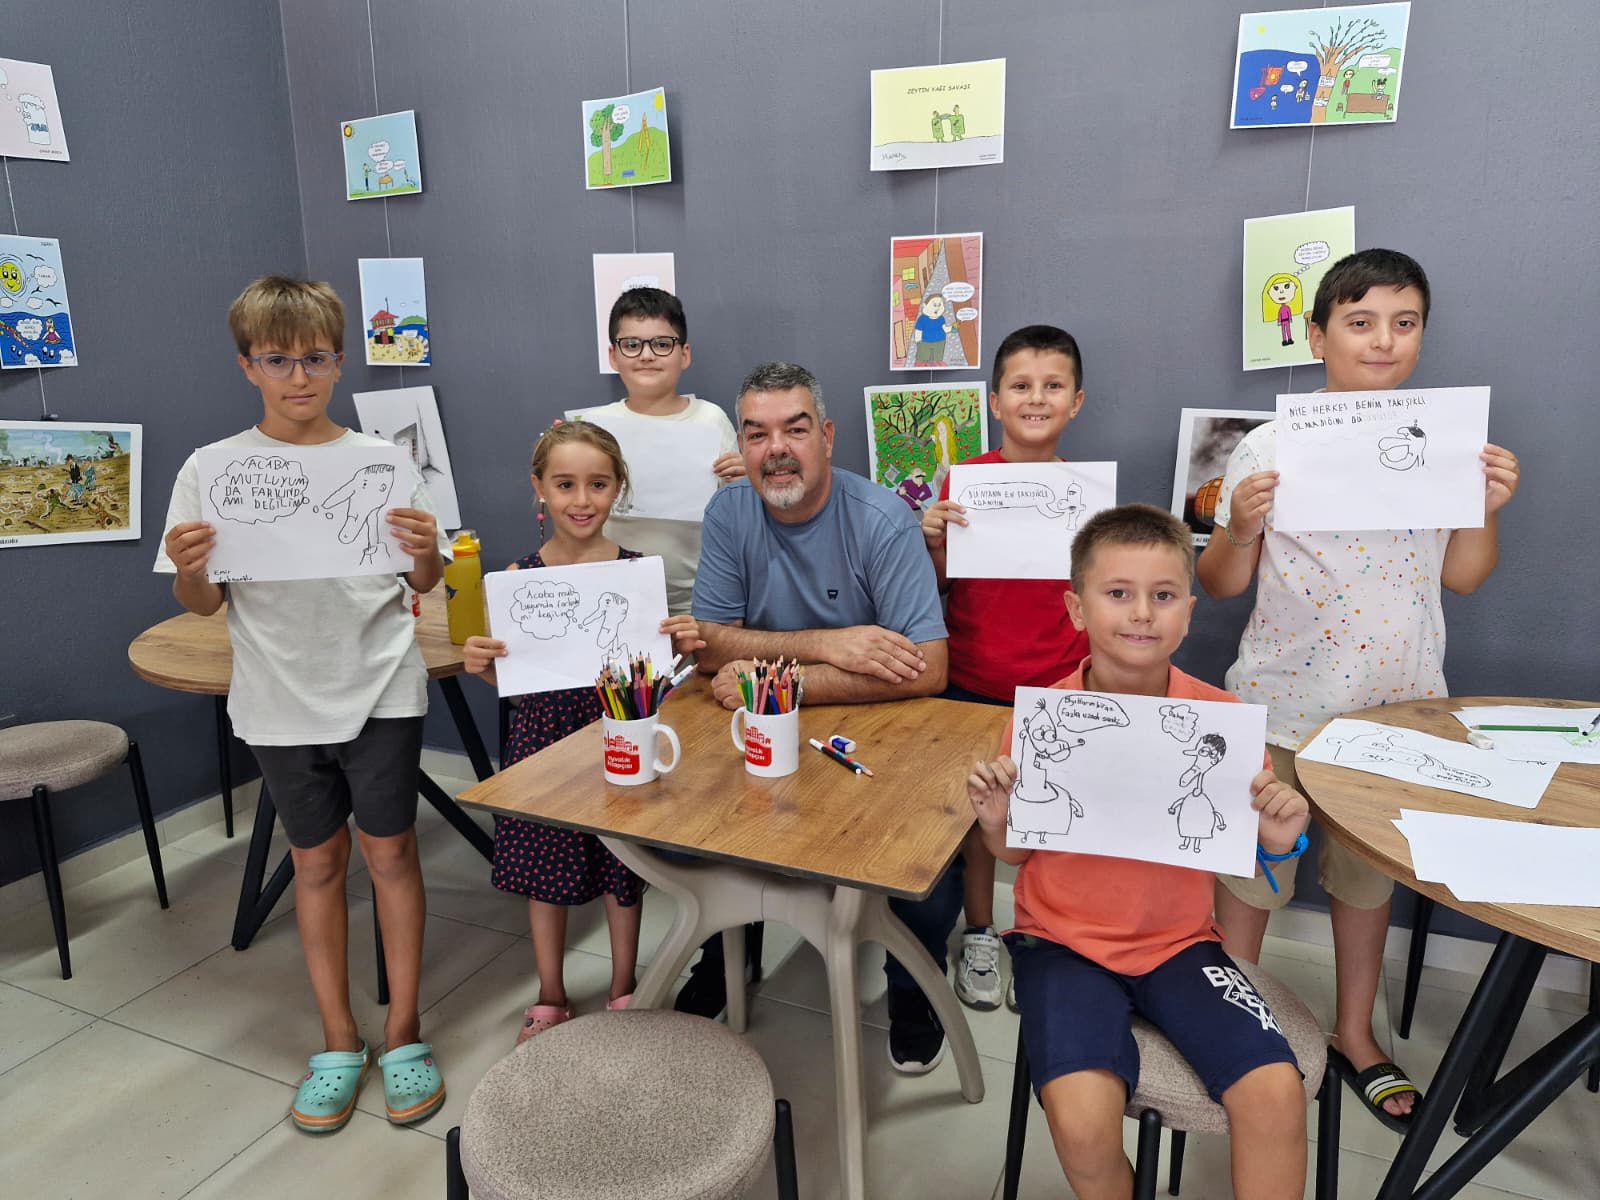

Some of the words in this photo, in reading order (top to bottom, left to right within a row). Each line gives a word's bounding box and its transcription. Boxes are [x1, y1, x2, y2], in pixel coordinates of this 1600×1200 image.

[247, 459, 290, 471] ACABA
[230, 473, 305, 488] MUTLUYUM
[225, 485, 241, 497] DA
